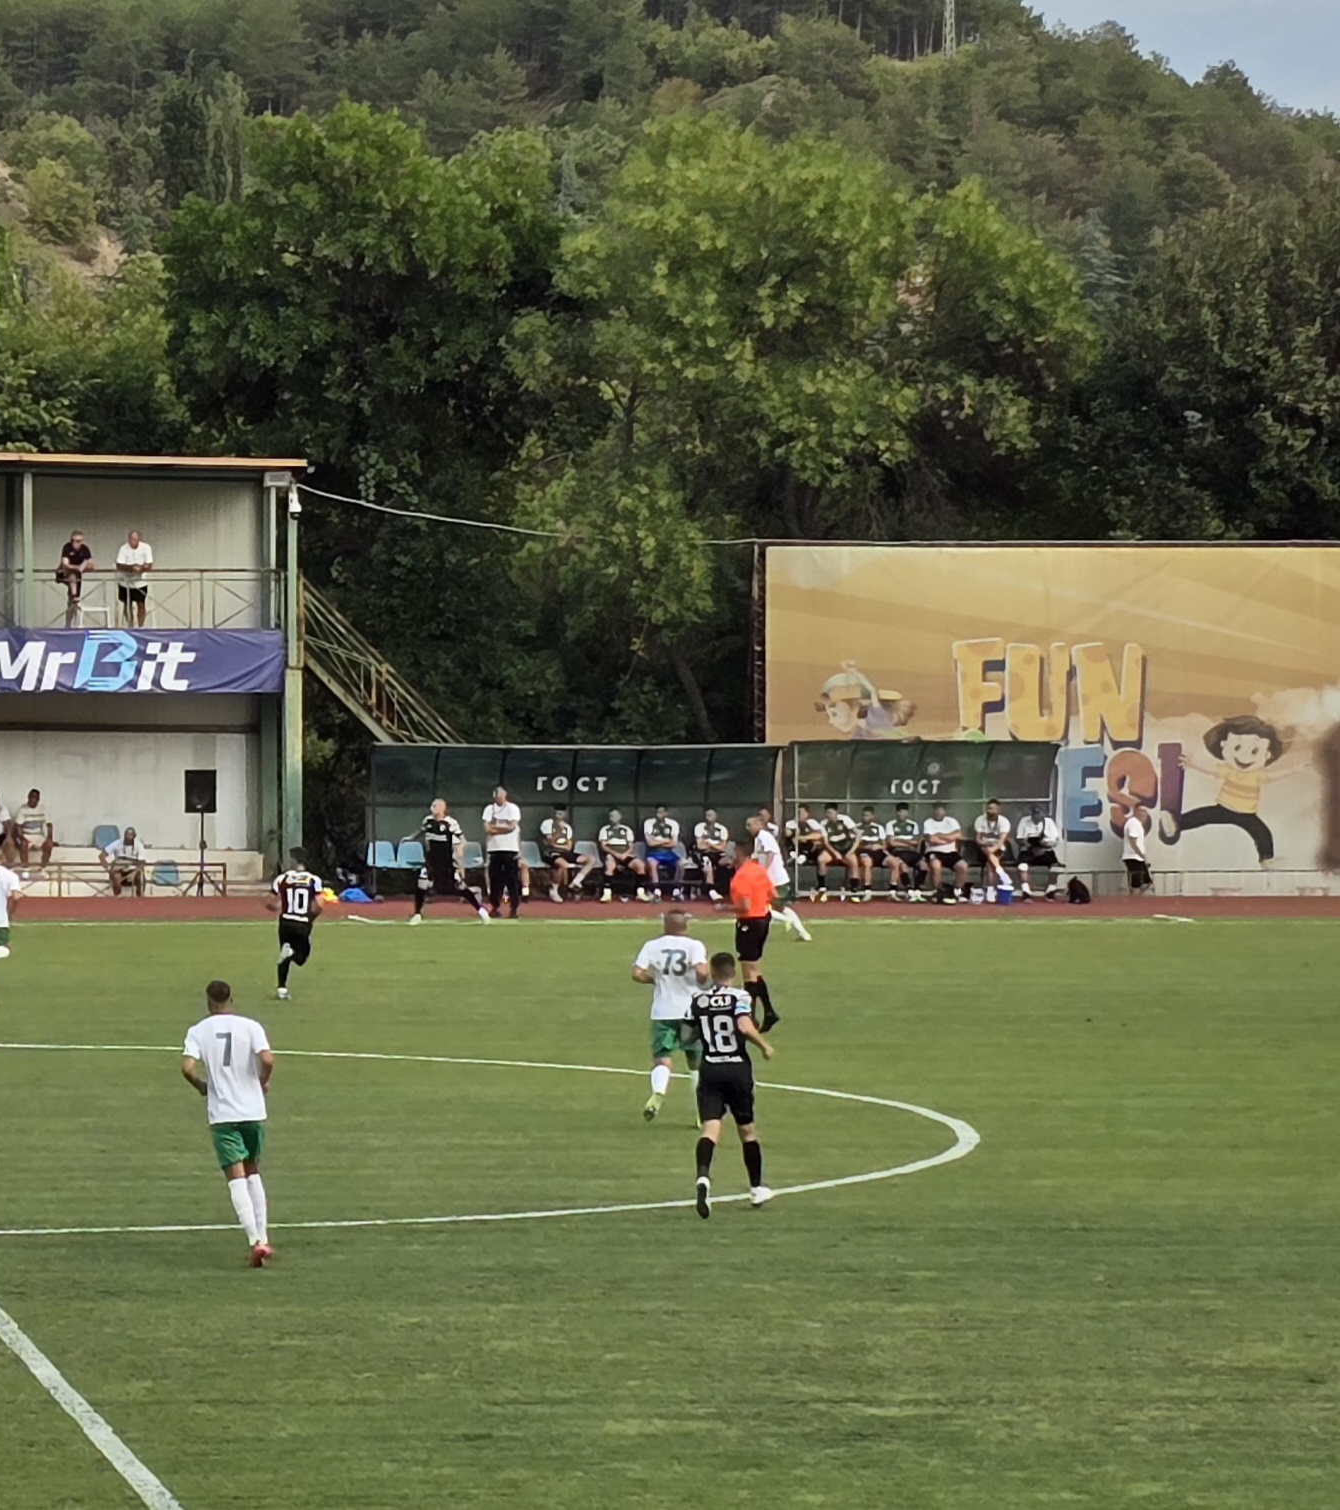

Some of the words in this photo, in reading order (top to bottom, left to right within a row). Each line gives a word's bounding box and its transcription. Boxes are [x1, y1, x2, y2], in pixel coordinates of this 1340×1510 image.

[952, 637, 1146, 751] FUN
[536, 776, 608, 792] ГОСТ
[890, 779, 941, 795] ГОСТ
[286, 888, 309, 914] 10
[661, 949, 687, 976] 73
[700, 1015, 738, 1053] 18
[216, 1032, 232, 1067] 7
